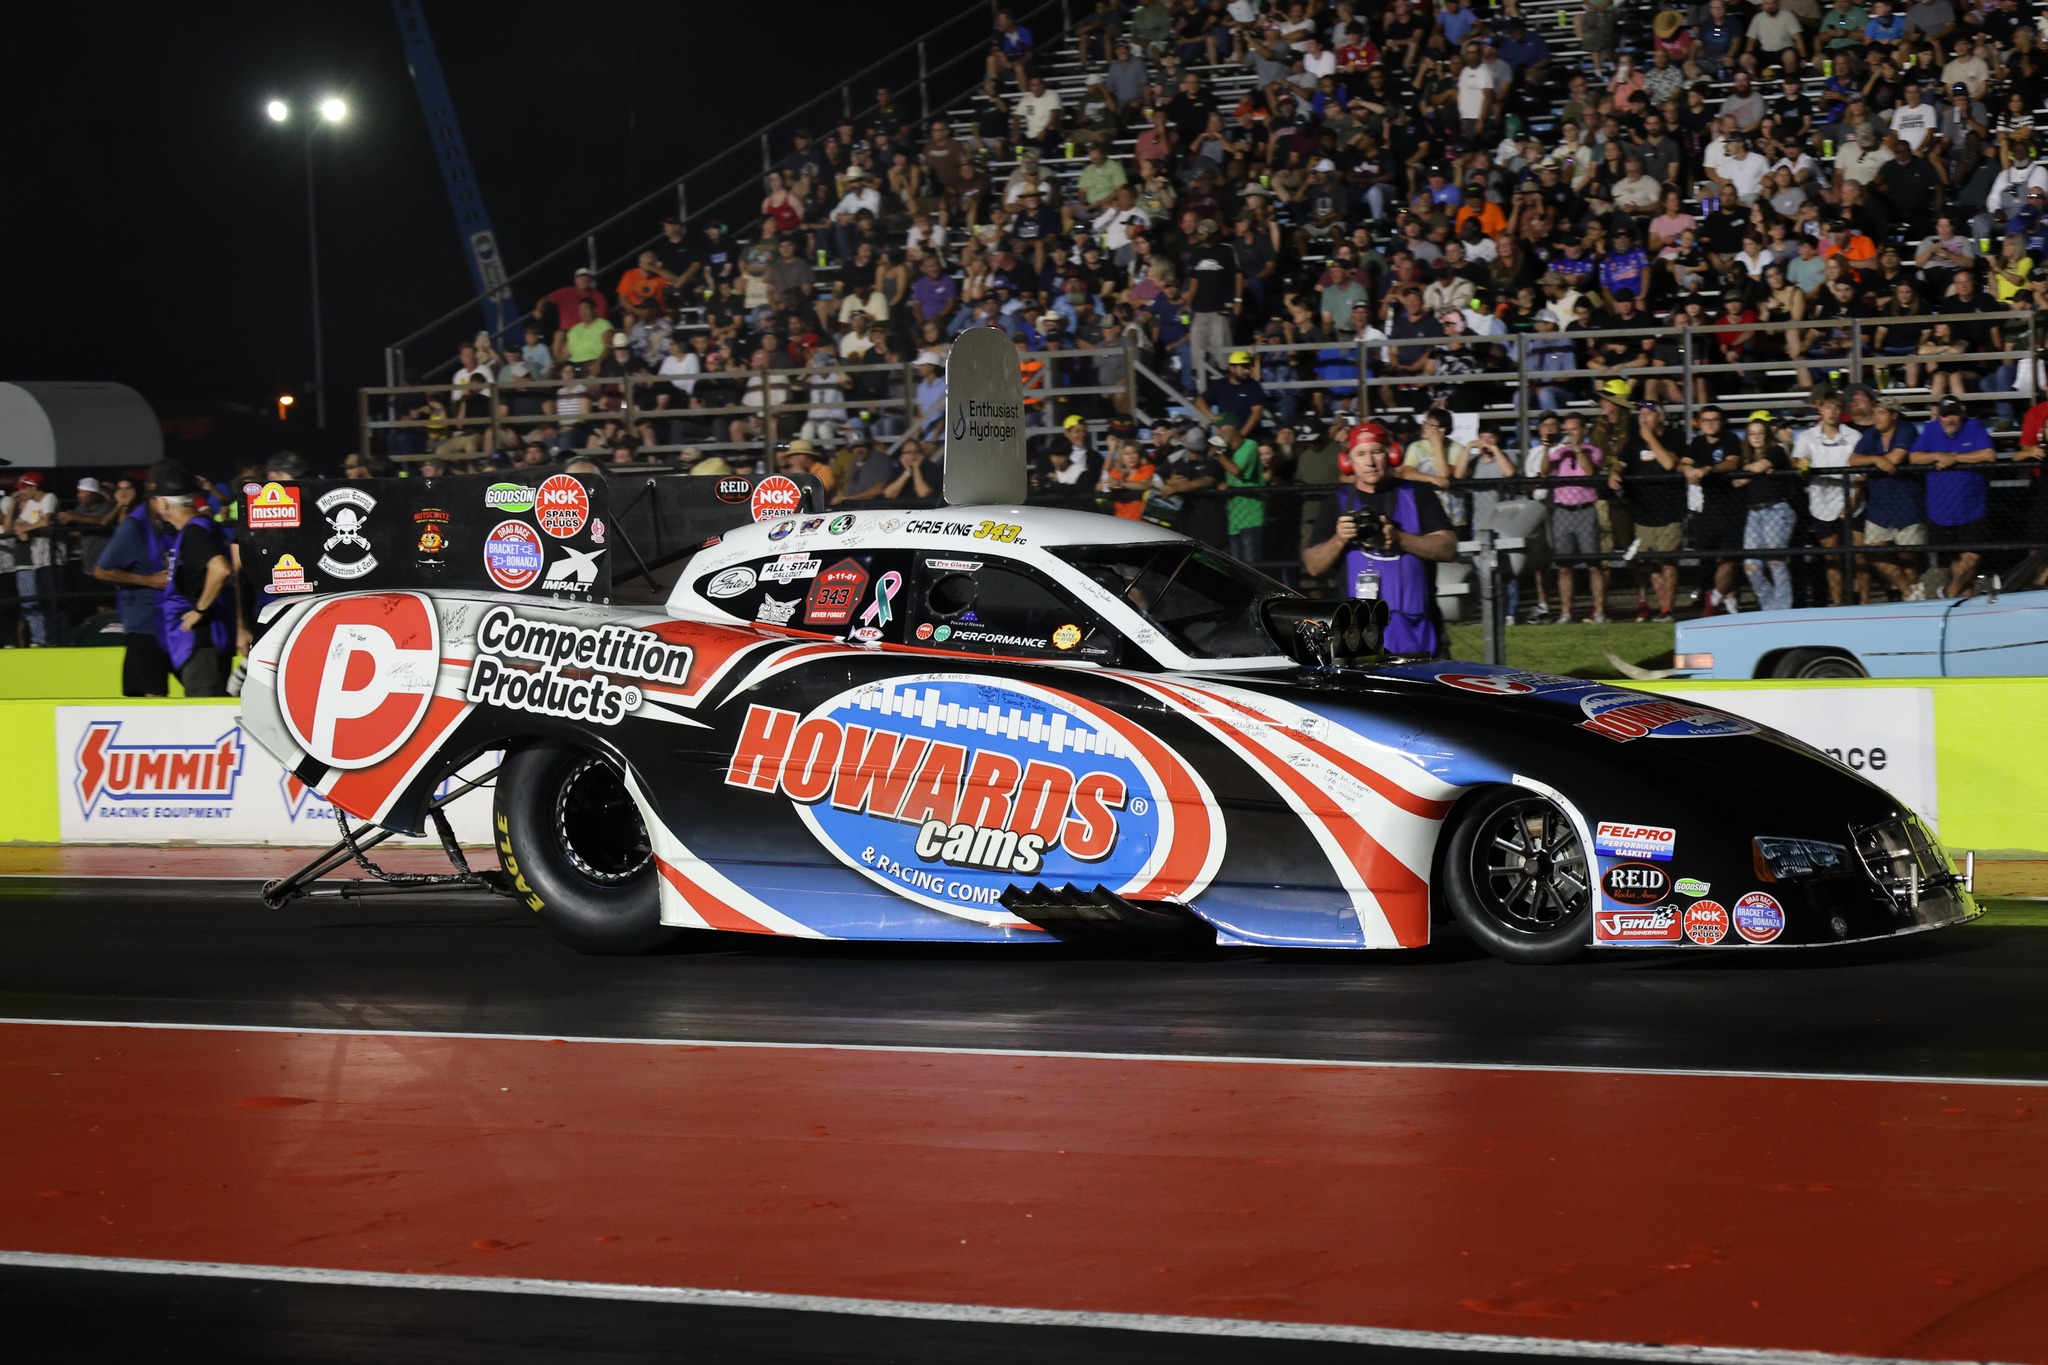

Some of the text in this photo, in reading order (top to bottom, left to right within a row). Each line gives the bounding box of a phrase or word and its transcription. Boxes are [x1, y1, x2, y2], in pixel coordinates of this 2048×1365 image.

[969, 400, 1019, 419] Enthusiast
[969, 421, 1016, 441] Hydrogen
[720, 481, 749, 493] REID
[485, 490, 535, 503] GOODSON
[543, 490, 579, 505] NGK
[760, 490, 794, 504] NGK
[252, 506, 296, 519] MISSION
[546, 510, 579, 518] SPARK
[762, 509, 793, 517] SPARK
[546, 519, 579, 528] PLUGS
[906, 520, 974, 537] CHRIS KING
[497, 525, 531, 540] DRAG RACE
[973, 520, 1022, 543] 343
[489, 543, 520, 555] BRACKET
[506, 556, 538, 568] BONANZA
[766, 565, 785, 574] ALL
[828, 573, 857, 582] 9-11-01
[276, 584, 311, 592] CHALLENGE
[542, 580, 592, 592] IMPACT
[818, 588, 850, 606] 343
[482, 611, 688, 679] Competition
[952, 630, 1047, 648] PERFORMANCE
[1825, 747, 1887, 770] nce
[724, 702, 1128, 860] HOWARDS
[100, 807, 232, 818] RACING EQUIPMENT
[1598, 825, 1674, 842] FEL-PRO
[915, 819, 1046, 873] cams
[1603, 840, 1666, 852] PERFORMANCE
[1615, 849, 1652, 859] GASKETS
[497, 811, 545, 912] EAGLE
[861, 846, 1001, 905] & RACING COMP
[1611, 869, 1664, 889] REID
[1613, 889, 1658, 899] Rocker Arms
[1676, 882, 1709, 893] GOODSON
[1745, 895, 1774, 907] DRAG RACE
[1691, 911, 1721, 922] NGK
[1737, 907, 1765, 918] BRACKET
[1600, 913, 1676, 936] Sander
[1752, 917, 1780, 928] BONANZA
